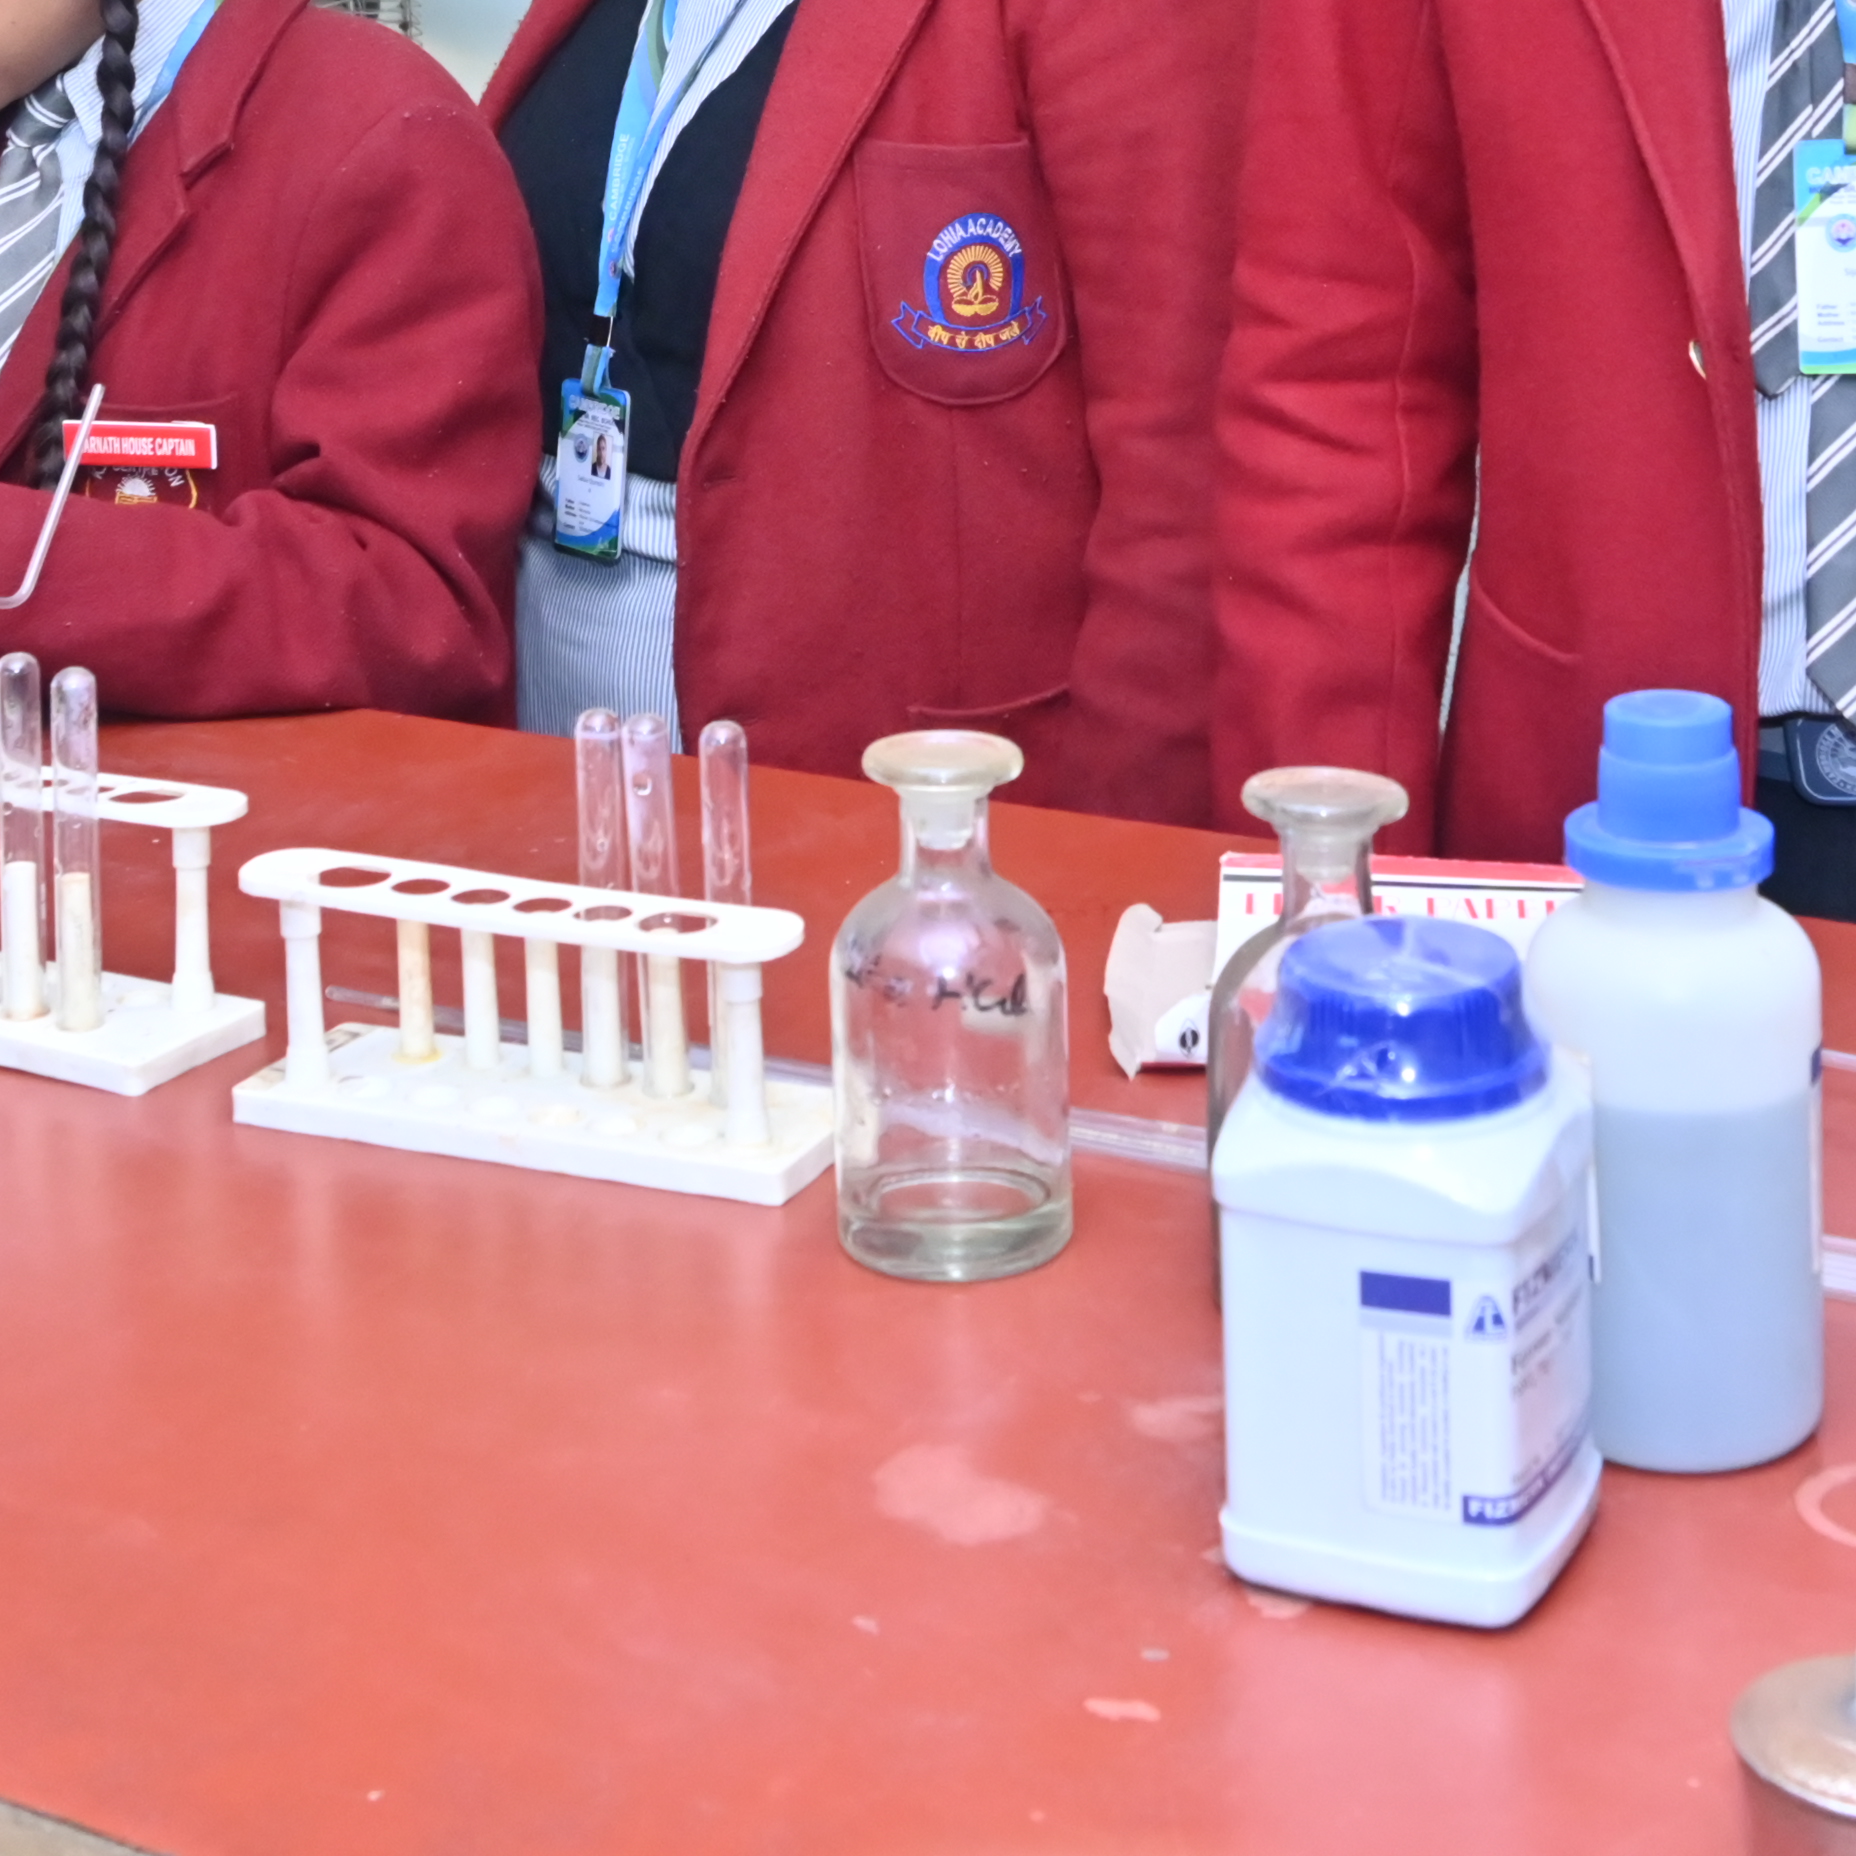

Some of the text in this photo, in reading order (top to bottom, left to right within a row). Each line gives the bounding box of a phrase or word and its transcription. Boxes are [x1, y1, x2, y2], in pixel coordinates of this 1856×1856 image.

[609, 133, 630, 221] CAMBRIDGE
[927, 218, 1023, 262] LOHIA ACADEMY
[82, 436, 196, 456] ARNATH HOUSE CAPTAIN
